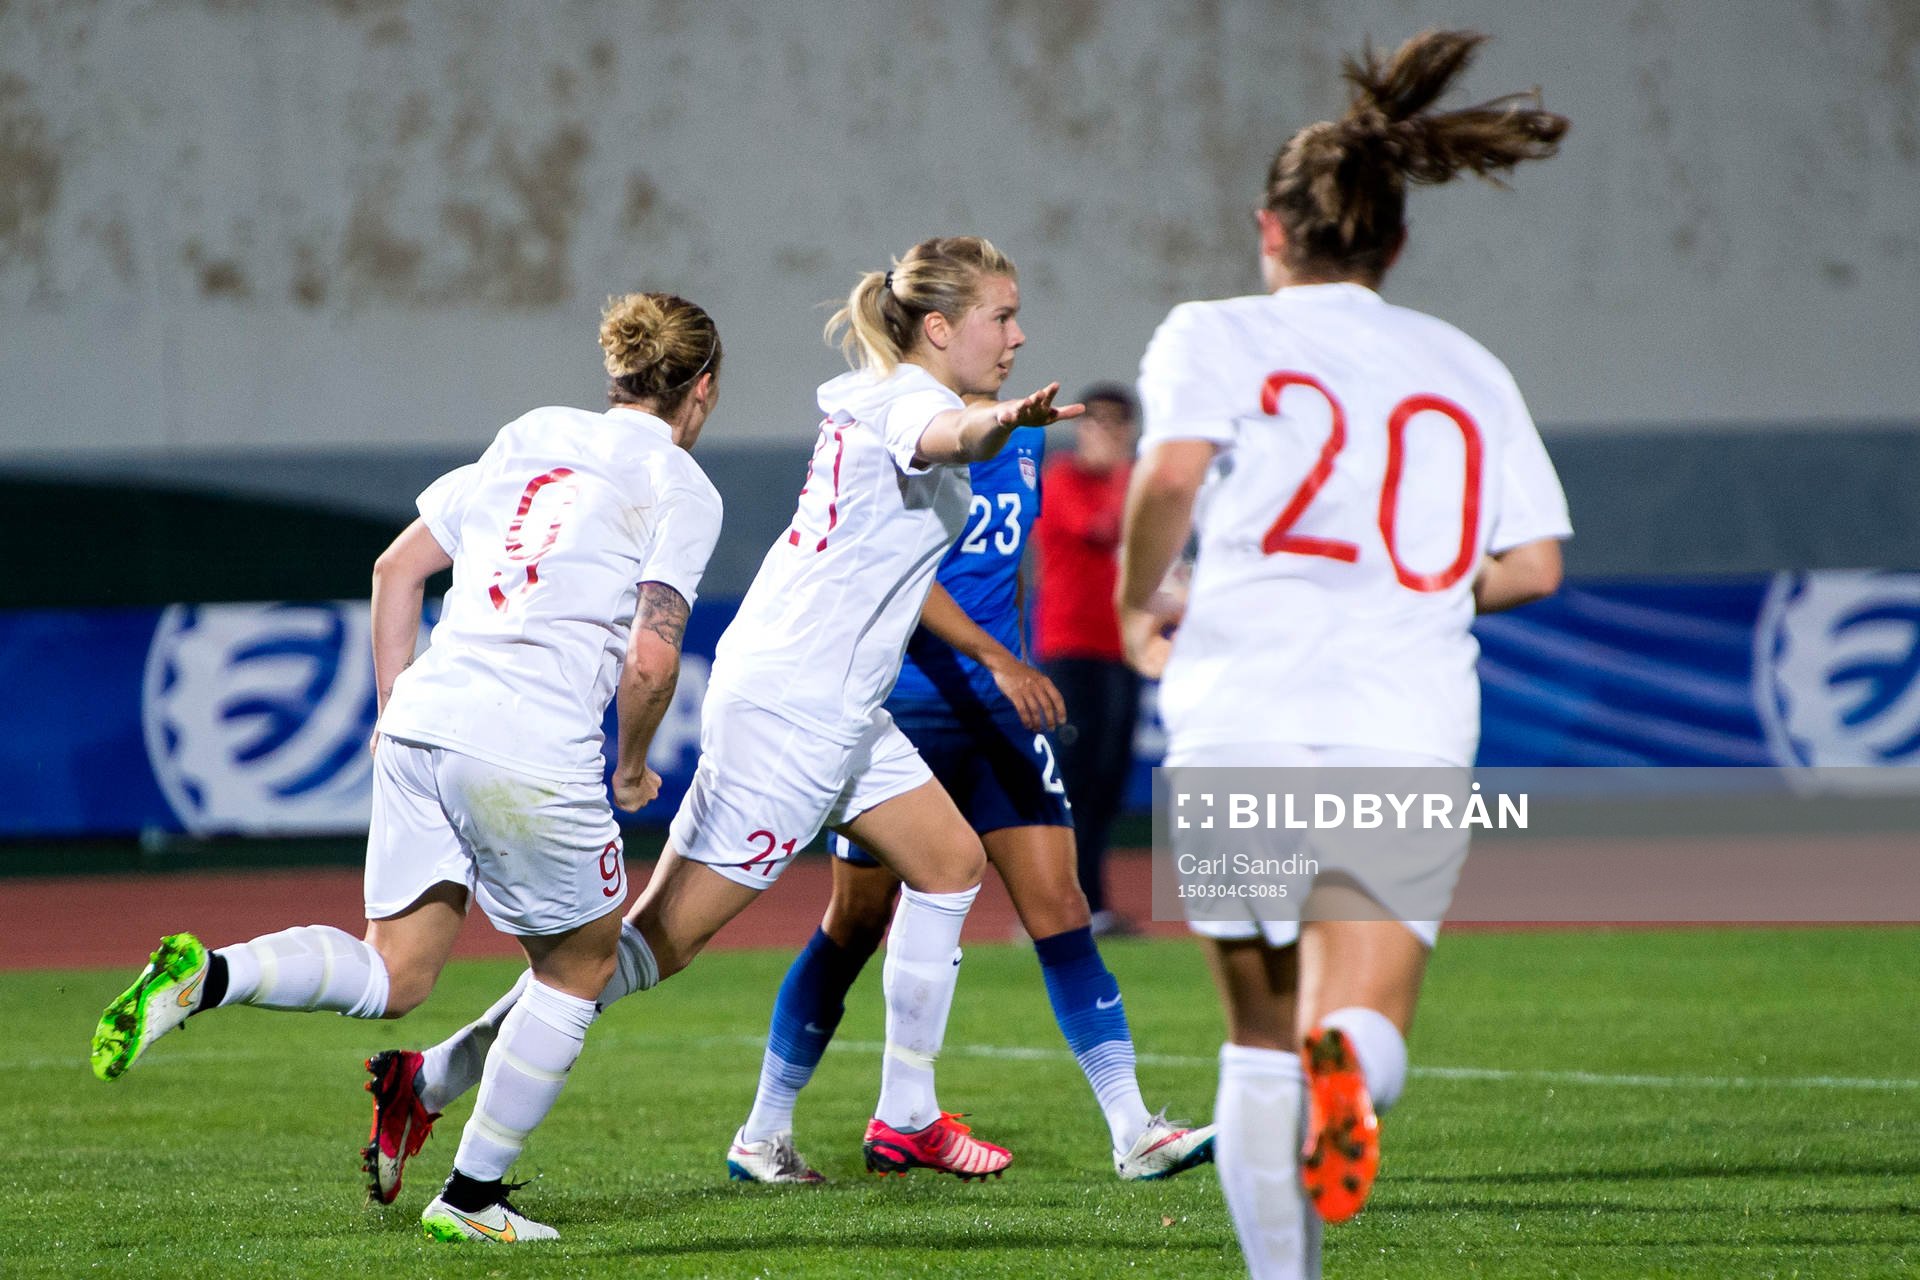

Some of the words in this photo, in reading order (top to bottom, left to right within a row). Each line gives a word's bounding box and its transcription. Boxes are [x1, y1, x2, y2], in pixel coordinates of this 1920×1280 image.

[1260, 370, 1484, 592] 20
[488, 467, 577, 613] 9
[960, 492, 1022, 555] 23
[1033, 733, 1072, 809] 2
[599, 840, 622, 897] 9
[740, 829, 798, 876] 21
